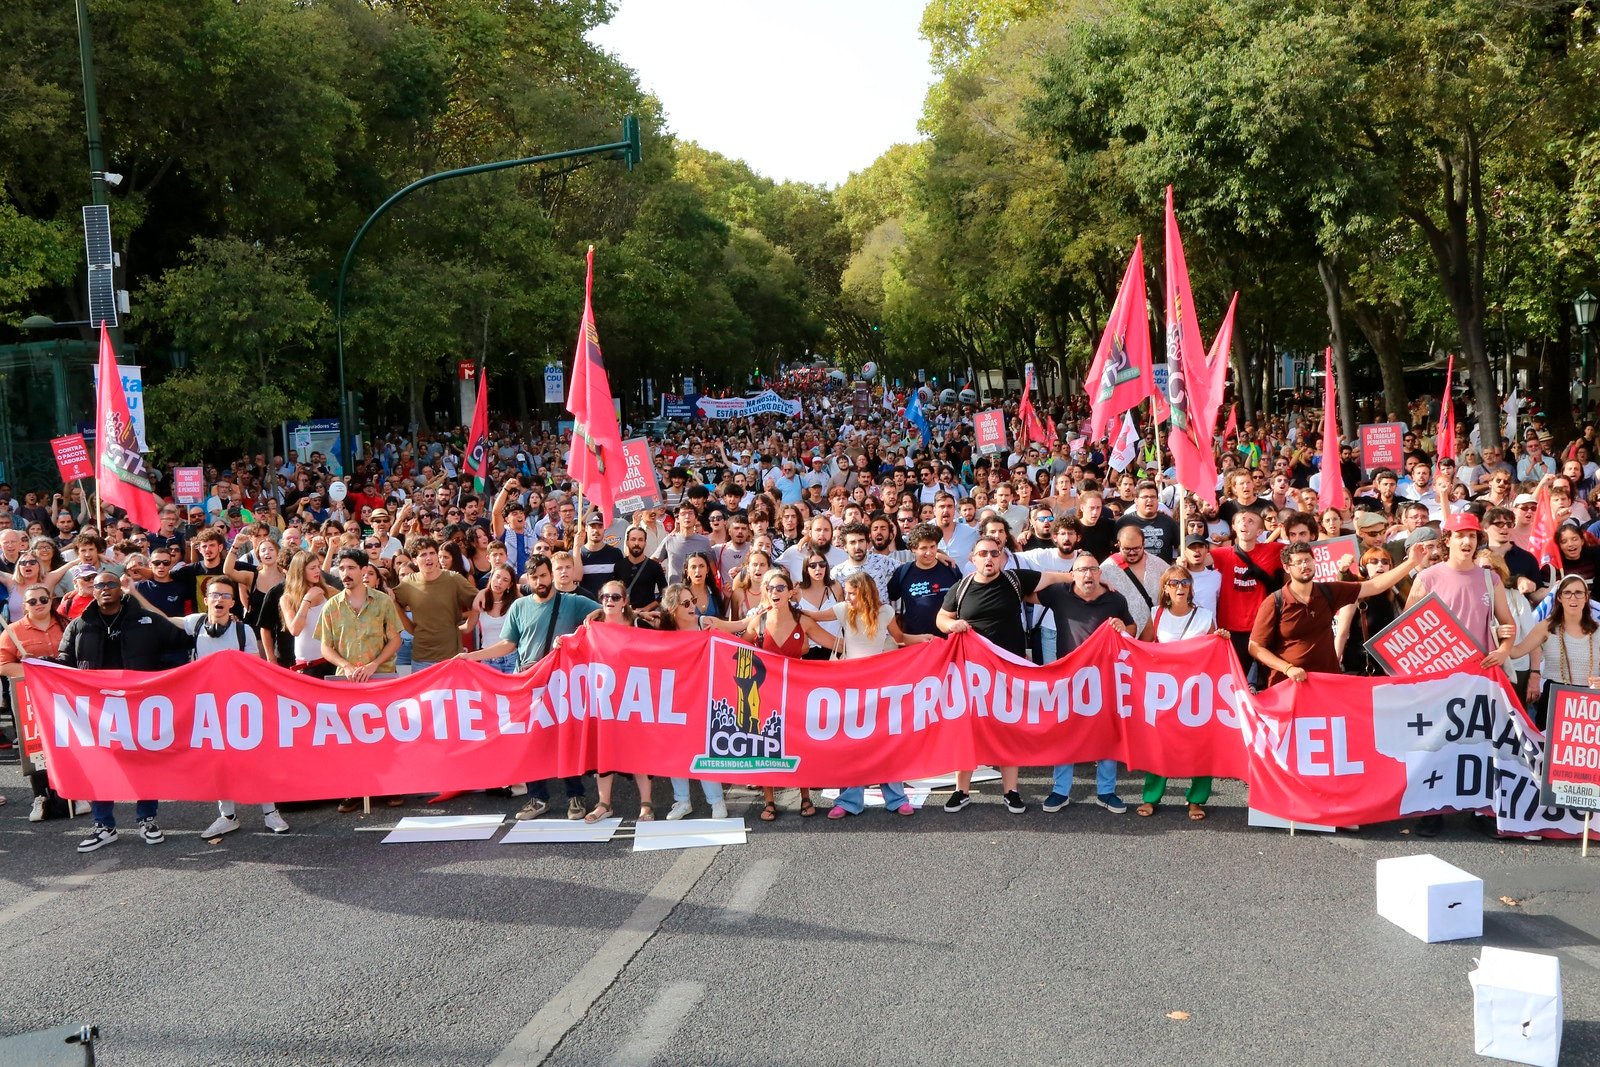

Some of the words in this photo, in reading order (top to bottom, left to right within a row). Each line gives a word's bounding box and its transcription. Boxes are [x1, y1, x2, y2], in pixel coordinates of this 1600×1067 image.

[980, 419, 998, 428] HORAS
[982, 426, 997, 434] PARA
[982, 433, 1000, 441] TODOS
[57, 444, 83, 454] CONTRA
[63, 450, 87, 459] PACOTE
[622, 445, 630, 456] 5
[60, 456, 87, 466] LABORAL
[626, 467, 641, 479] ARA
[1313, 546, 1330, 562] 35
[1315, 560, 1340, 578] ORA
[1383, 624, 1420, 658] NÃO
[1414, 609, 1441, 635] AO
[1396, 624, 1458, 675] PACOTE
[1417, 640, 1478, 676] BORAL
[805, 661, 966, 741] OUTRO
[964, 660, 1103, 724] RUMO
[1114, 649, 1133, 719] É
[53, 689, 176, 751] NÃO
[190, 691, 263, 751] AO
[277, 688, 487, 748] PACOTE
[495, 662, 687, 734] LABORAL
[1564, 695, 1600, 721] NÃO
[1407, 712, 1433, 736] +
[711, 731, 781, 758] CGTP
[699, 760, 753, 768] INTERSINDICAL
[754, 760, 790, 768] NACIONAL
[1552, 743, 1600, 769] LABO
[1422, 769, 1443, 790] +
[1563, 783, 1593, 796] SALÁRIO
[1565, 795, 1598, 807] DIREITOS
